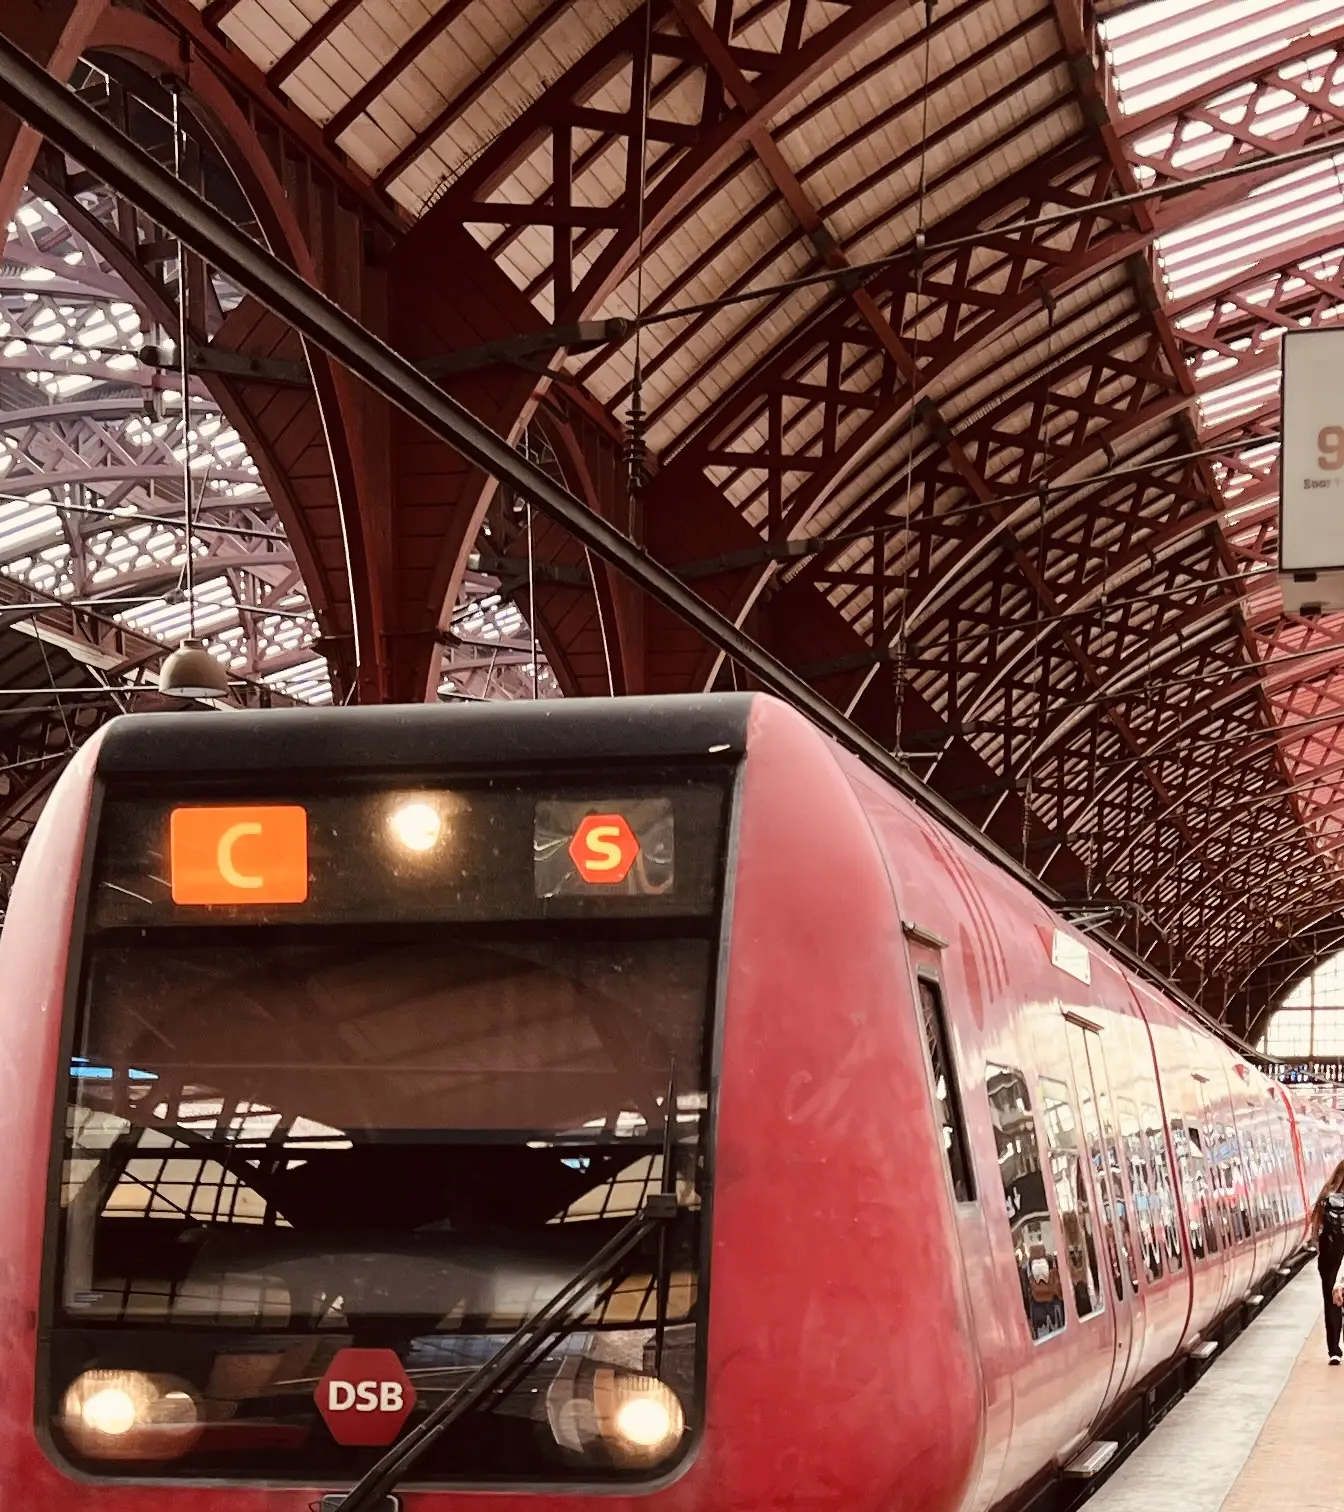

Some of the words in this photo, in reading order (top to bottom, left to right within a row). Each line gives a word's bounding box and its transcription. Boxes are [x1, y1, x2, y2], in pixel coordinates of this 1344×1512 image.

[217, 822, 264, 889] C
[584, 825, 622, 871] S
[328, 1381, 404, 1413] DSB
